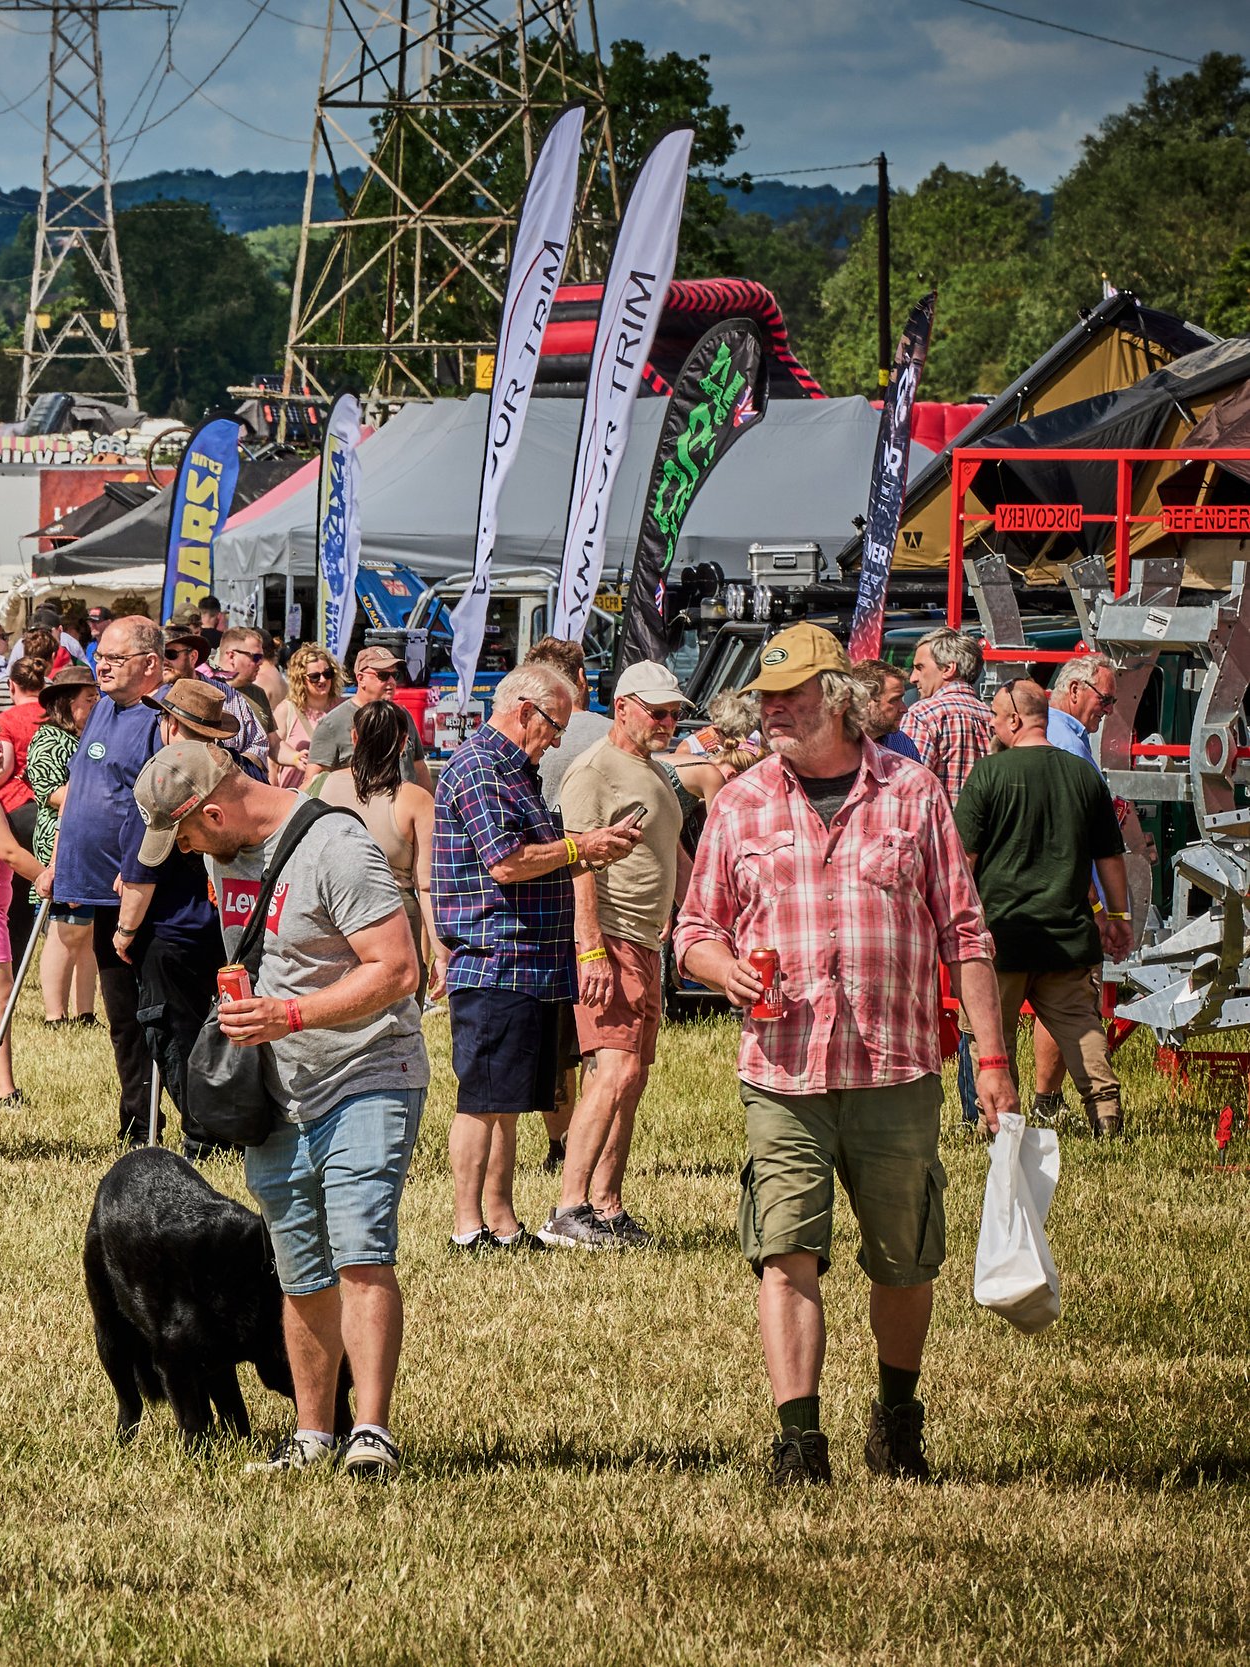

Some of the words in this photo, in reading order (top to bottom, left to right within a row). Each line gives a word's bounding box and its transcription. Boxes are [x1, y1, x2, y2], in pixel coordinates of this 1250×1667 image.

[519, 240, 564, 360] TRIM
[609, 270, 656, 399] TRIM
[1162, 508, 1250, 530] DEFENDER
